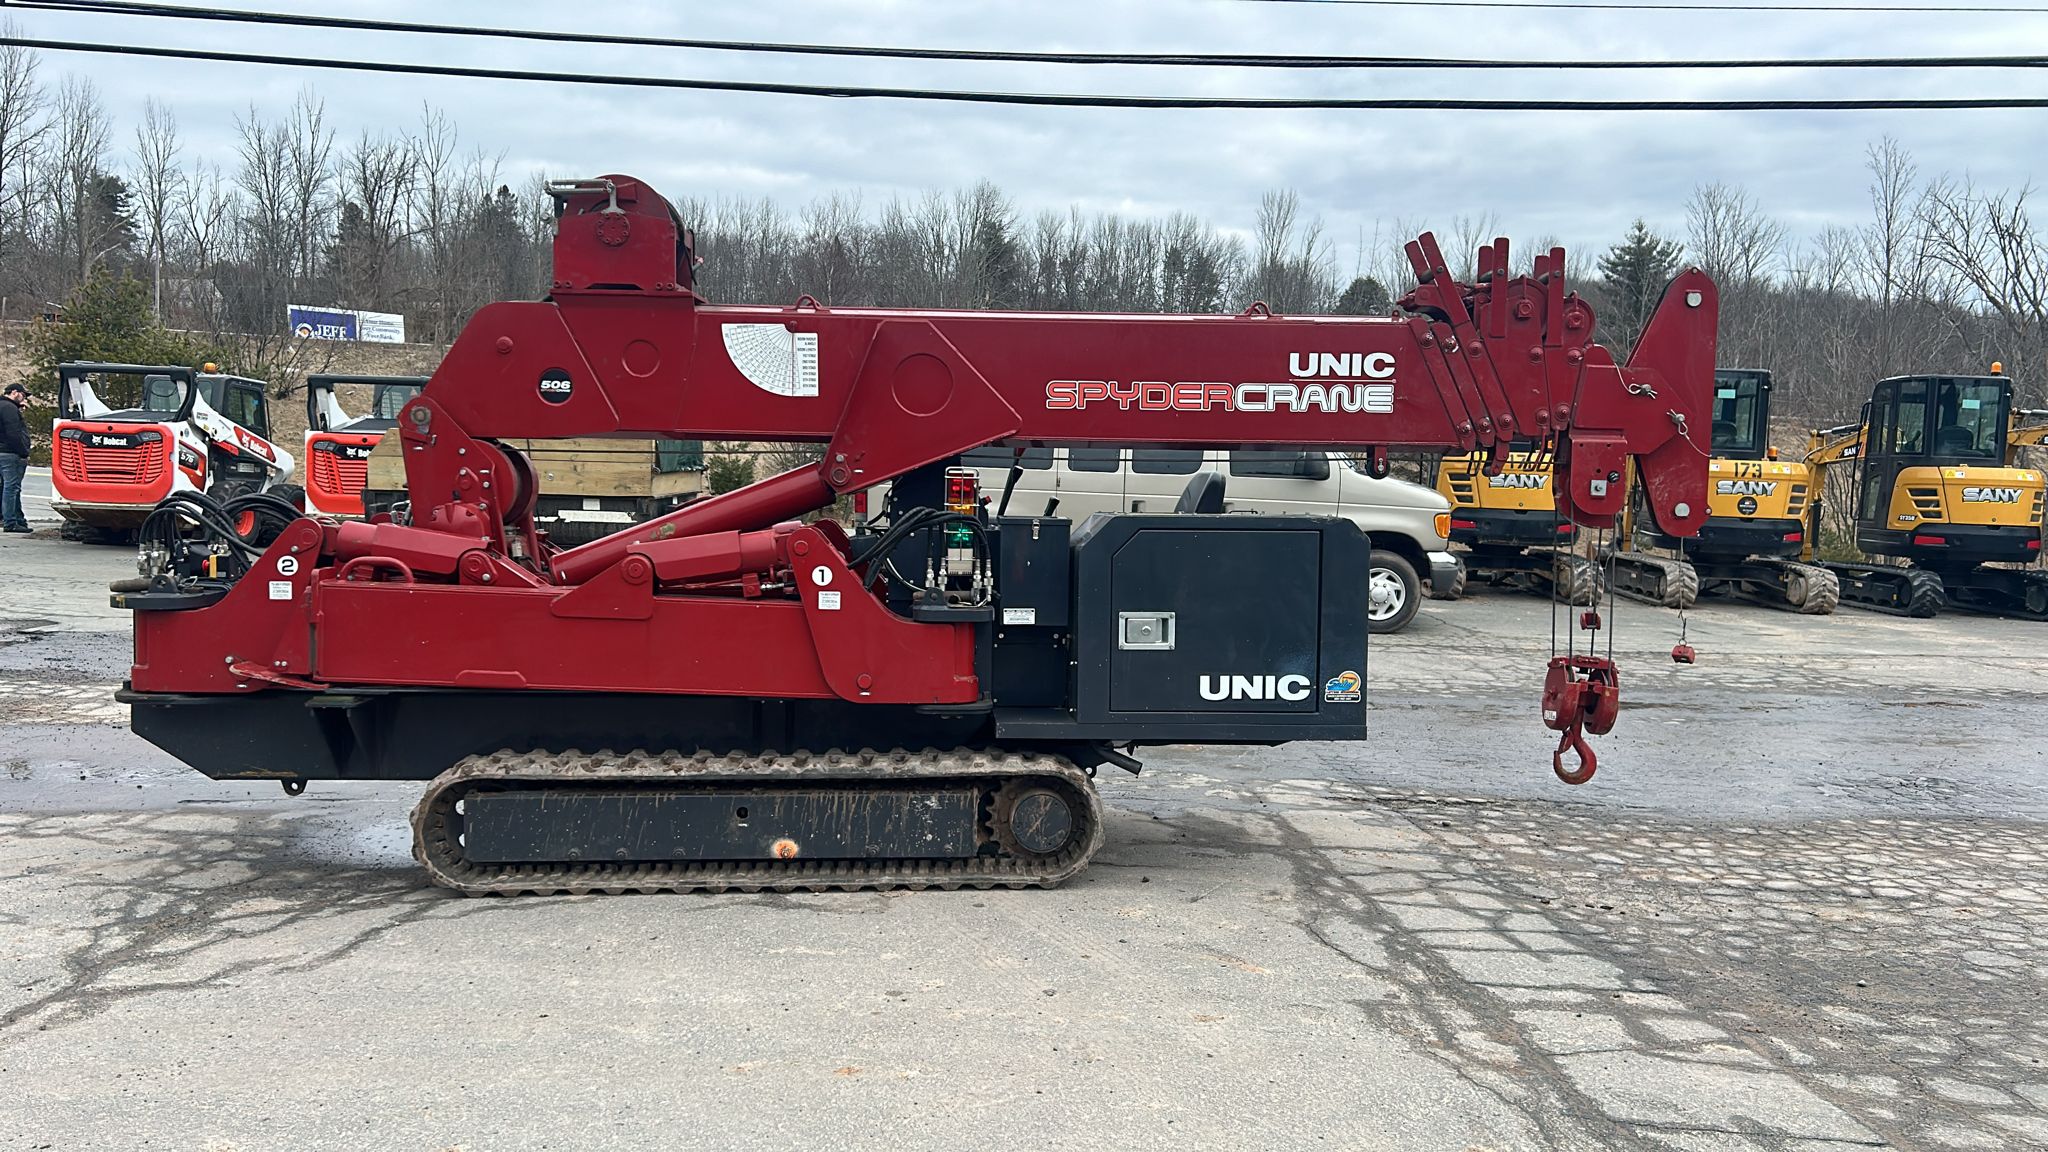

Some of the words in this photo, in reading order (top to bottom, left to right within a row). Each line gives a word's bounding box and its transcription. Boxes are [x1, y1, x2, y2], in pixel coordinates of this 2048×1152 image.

[315, 324, 347, 337] JEFF
[1289, 352, 1395, 378] UNIC
[541, 380, 571, 389] 506
[1046, 380, 1395, 413] SPYDERCRANE
[103, 437, 127, 446] Bobcat
[250, 440, 268, 456] Bobcat
[1735, 462, 1762, 478] 173
[1489, 473, 1549, 489] SANY
[1716, 480, 1778, 496] SANY
[1962, 487, 2023, 503] SANY
[281, 559, 294, 572] 2
[818, 569, 825, 582] 1
[1199, 674, 1311, 701] UNIC
